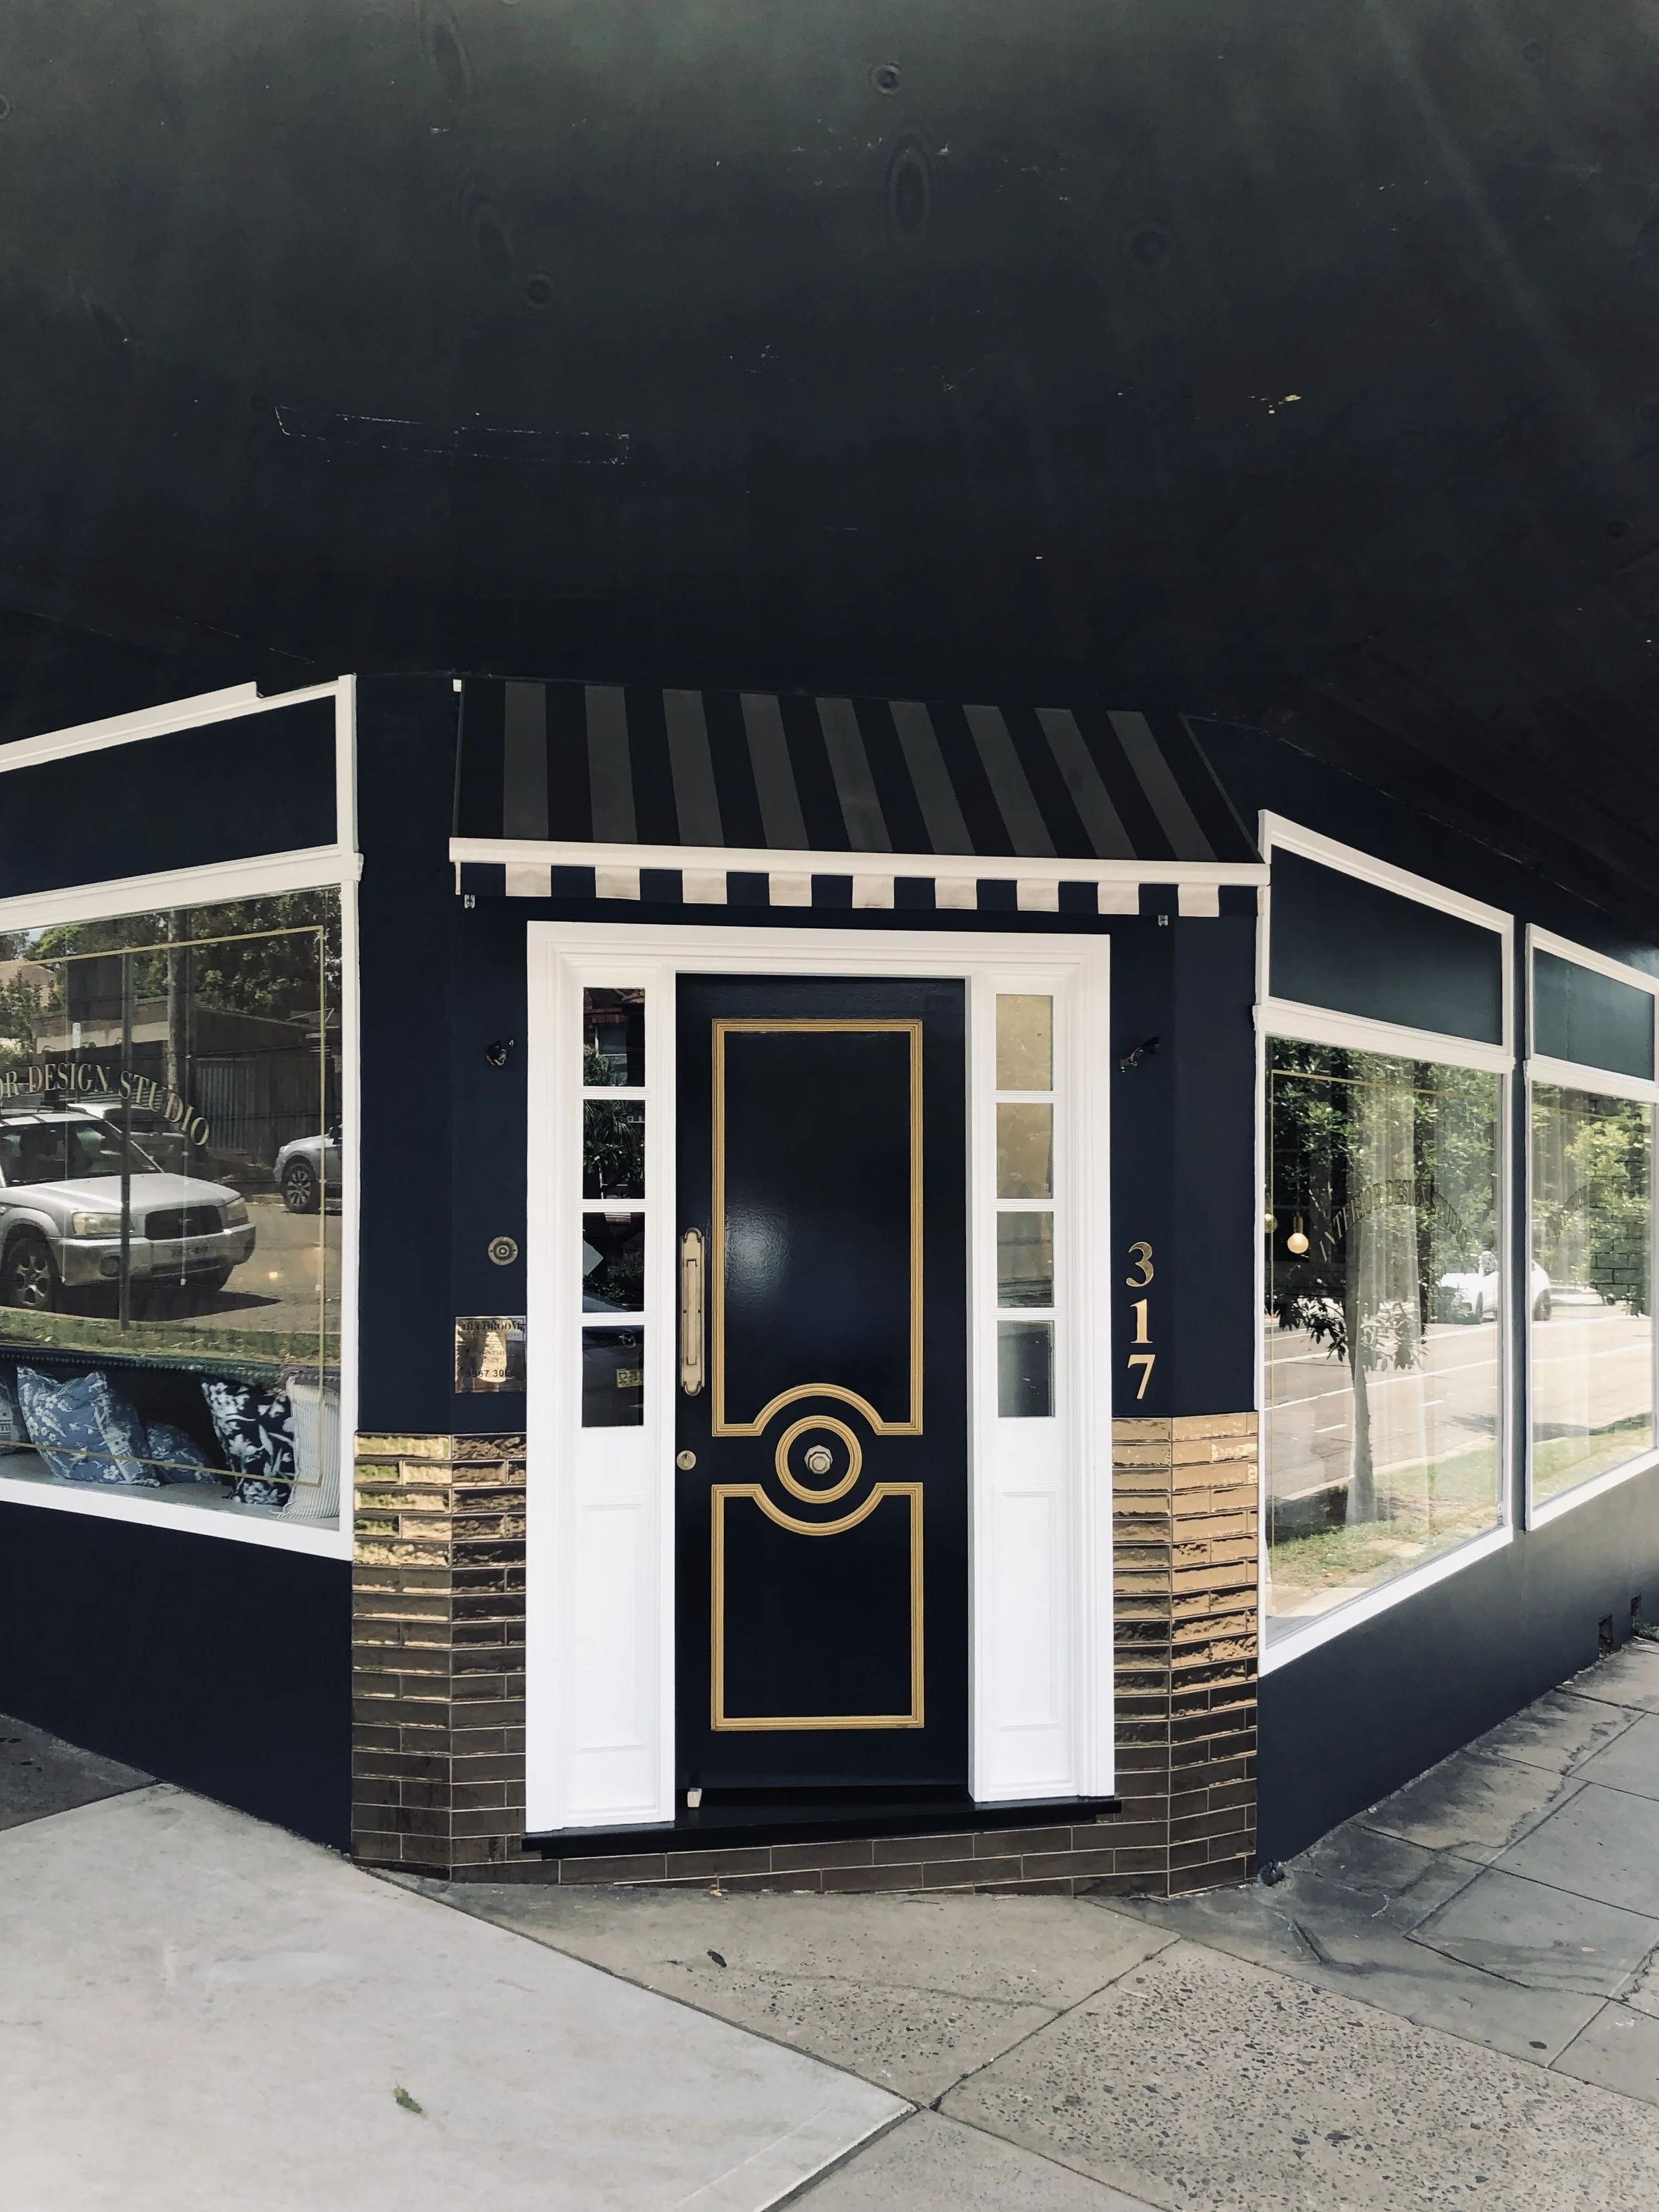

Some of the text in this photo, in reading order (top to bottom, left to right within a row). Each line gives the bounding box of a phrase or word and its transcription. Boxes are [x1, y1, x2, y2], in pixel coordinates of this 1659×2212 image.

[0, 1063, 210, 1146] R DESIGN STUDIO
[1126, 1241, 1156, 1399] 317
